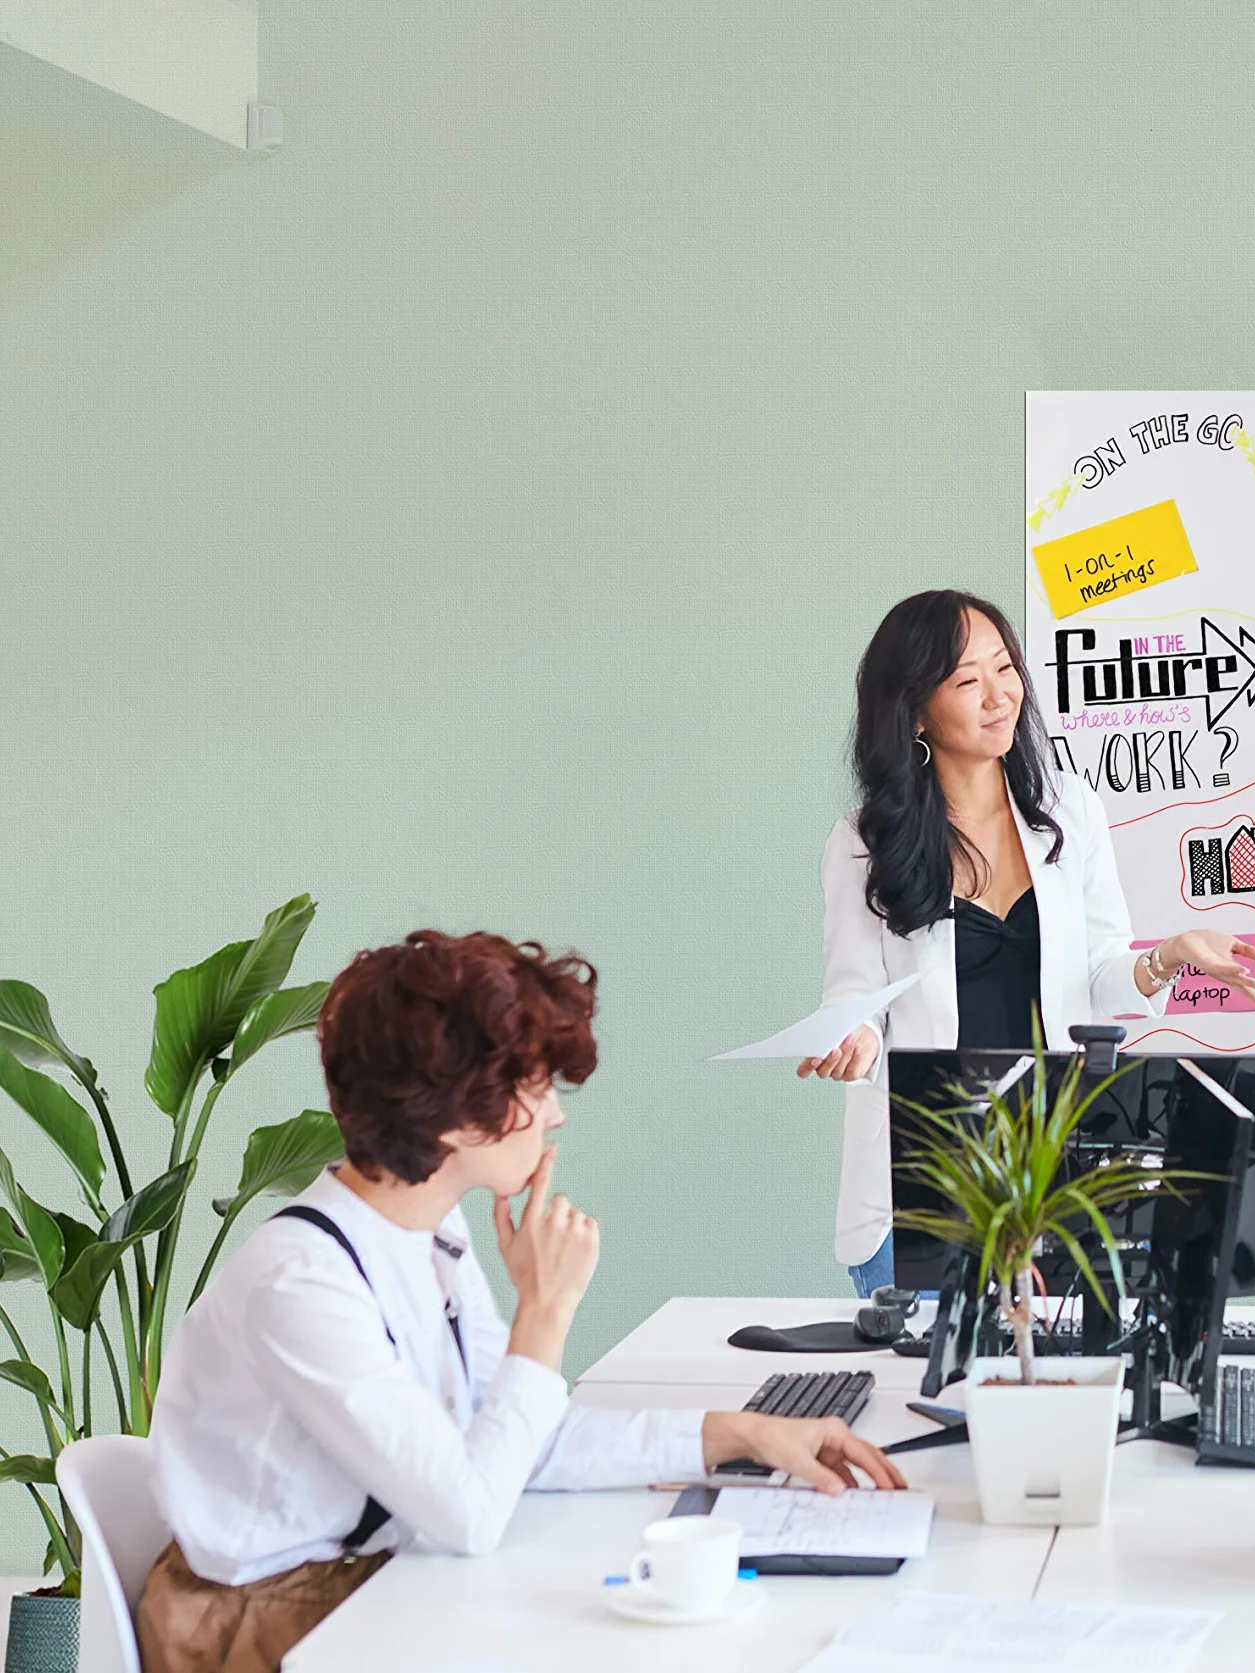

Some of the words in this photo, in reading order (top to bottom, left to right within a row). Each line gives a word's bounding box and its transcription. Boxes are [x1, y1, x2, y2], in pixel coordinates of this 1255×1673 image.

[1073, 437, 1127, 490] ON
[1128, 413, 1189, 455] THE
[1064, 545, 1134, 582] 1-on-1
[1079, 559, 1155, 603] meetings
[1134, 638, 1149, 655] IN
[1153, 634, 1186, 653] THE
[1055, 629, 1238, 713] future
[1061, 710, 1121, 730] where
[1123, 708, 1138, 727] &
[1139, 703, 1192, 726] how's
[1172, 984, 1231, 1007] laptop
